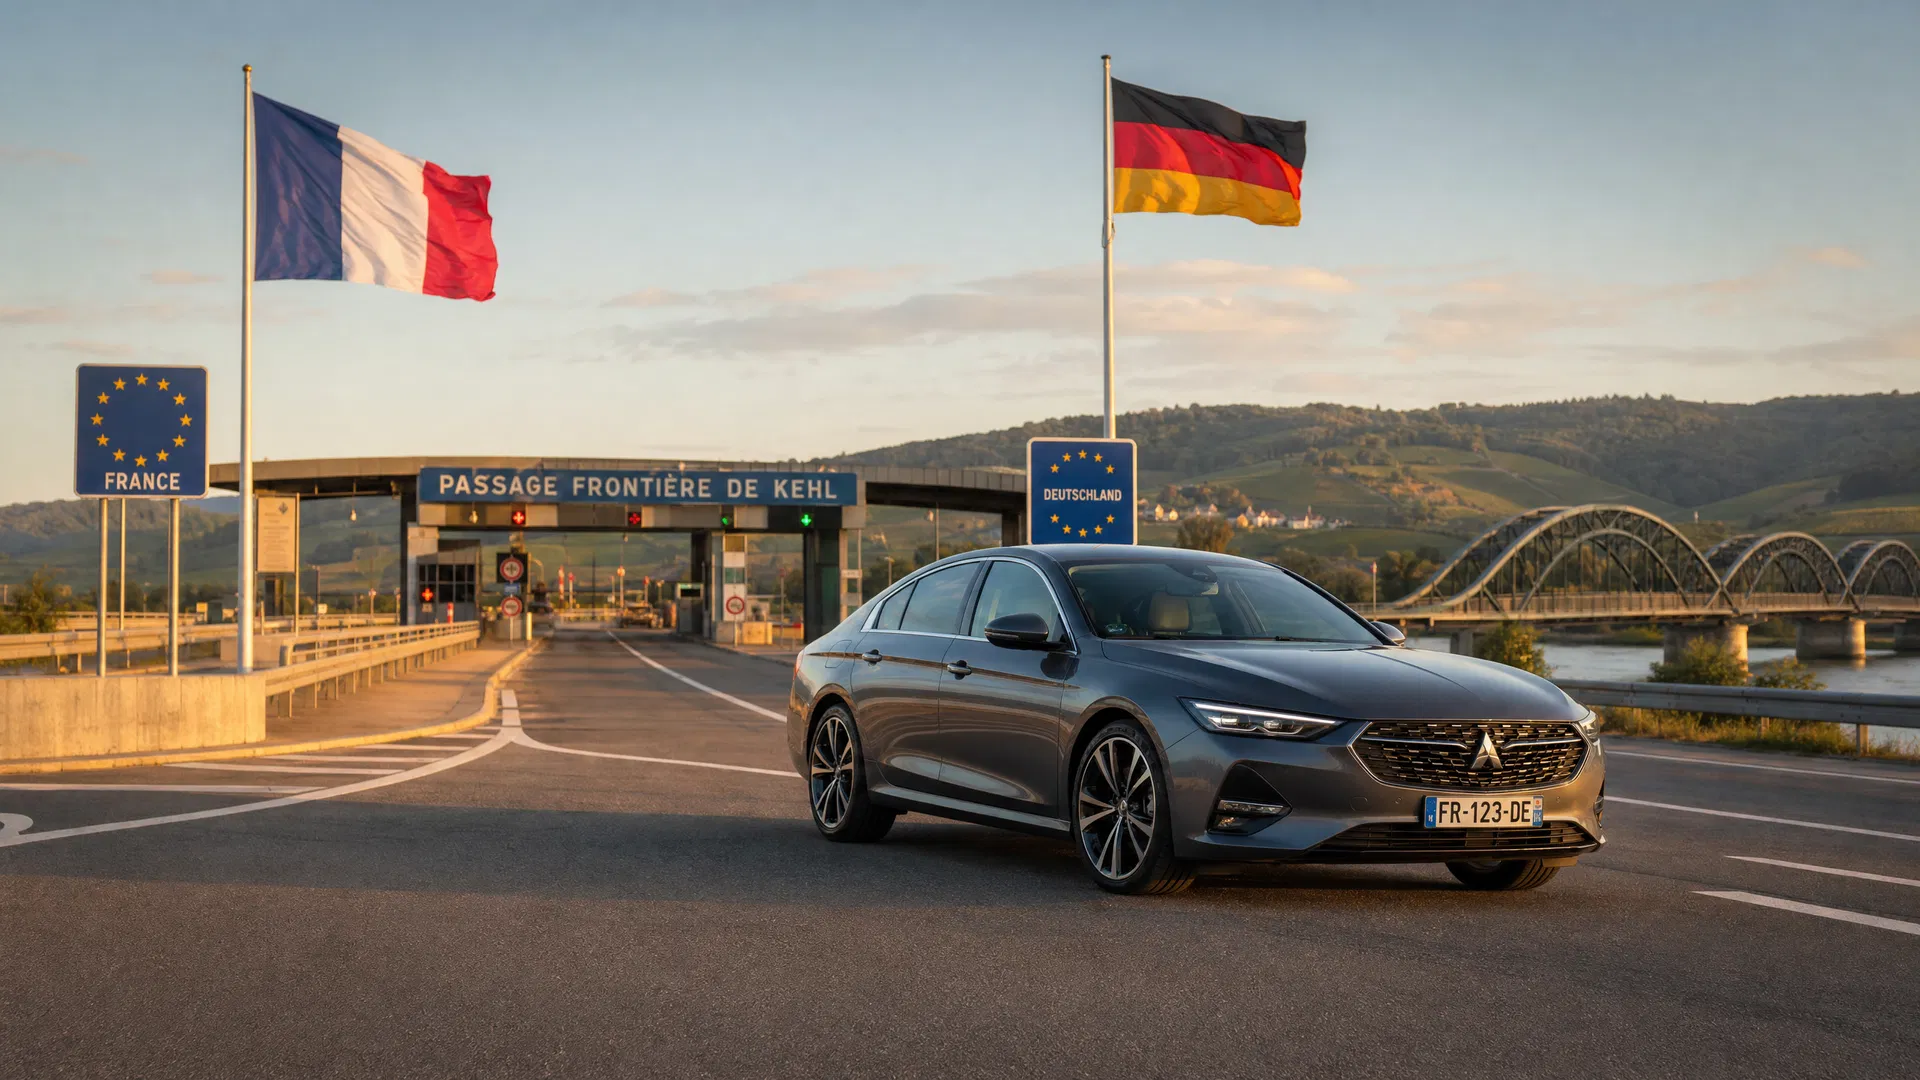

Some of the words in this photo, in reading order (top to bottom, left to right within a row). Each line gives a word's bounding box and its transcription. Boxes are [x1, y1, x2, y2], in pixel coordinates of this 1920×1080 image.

[105, 472, 181, 490] FRANCE
[439, 474, 558, 496] PASSAGE
[573, 473, 712, 498] FRONTIÈRE
[727, 479, 758, 498] DE
[774, 479, 837, 499] KEHL
[1043, 488, 1122, 501] DEUTSCHLAND
[1438, 800, 1531, 823] FR-123-DE
